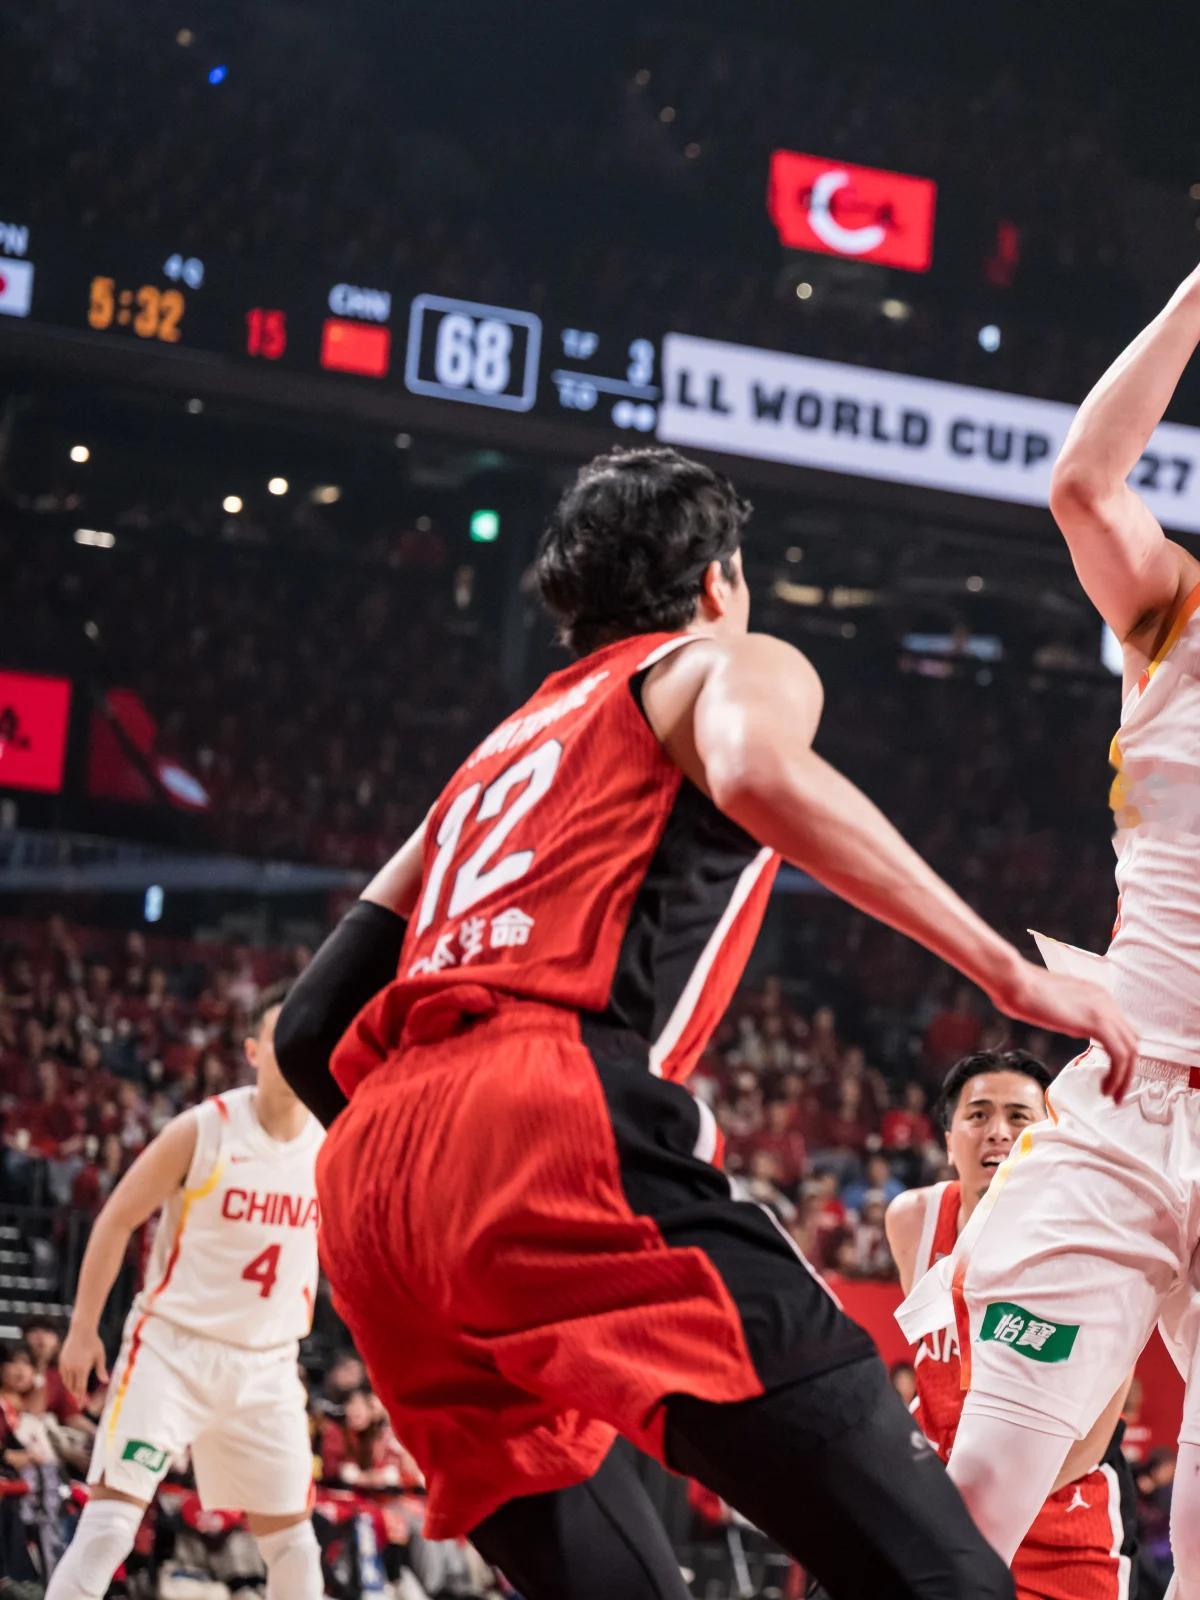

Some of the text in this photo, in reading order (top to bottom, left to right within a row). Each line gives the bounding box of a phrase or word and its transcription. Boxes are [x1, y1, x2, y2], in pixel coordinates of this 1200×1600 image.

[88, 275, 185, 343] 5:32
[328, 283, 392, 322] CHN
[247, 307, 287, 360] 15
[435, 312, 513, 394] 68
[628, 338, 655, 388] 3
[750, 381, 931, 448] WORLD
[949, 418, 1052, 467] CUP
[415, 738, 563, 938] 12
[221, 1186, 320, 1229] CHINA
[241, 1244, 282, 1299] 4
[993, 1313, 1057, 1352] 怡寶
